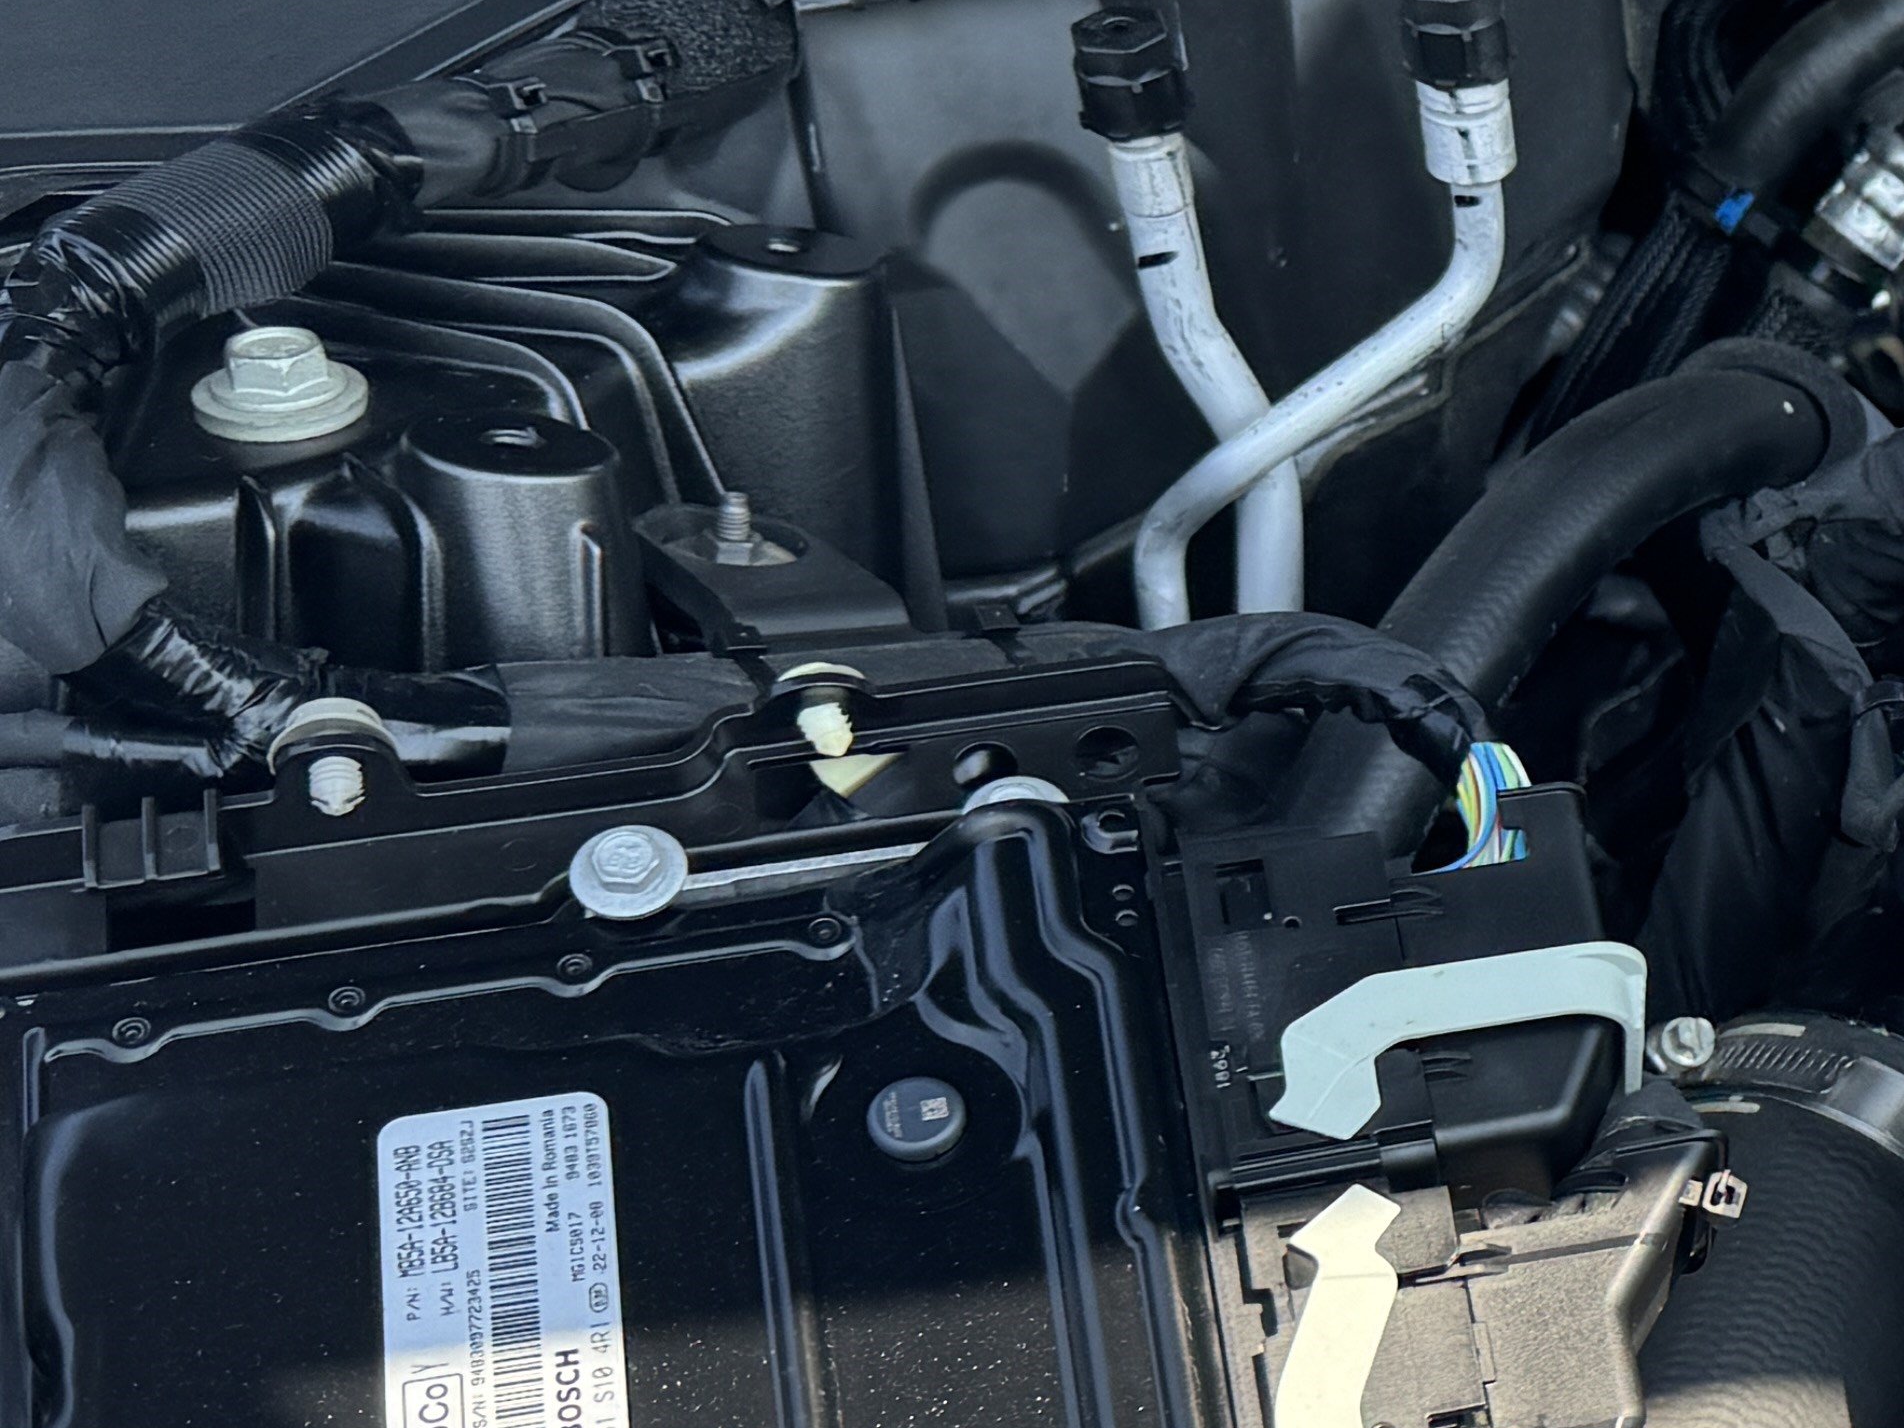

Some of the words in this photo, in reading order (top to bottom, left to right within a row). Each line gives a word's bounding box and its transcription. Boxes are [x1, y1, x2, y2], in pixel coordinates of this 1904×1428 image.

[541, 1108, 559, 1172] Romania
[544, 1192, 561, 1233] Made
[406, 1286, 422, 1321] P/N:
[410, 1362, 450, 1374] Y
[472, 1394, 488, 1428] S/N:
